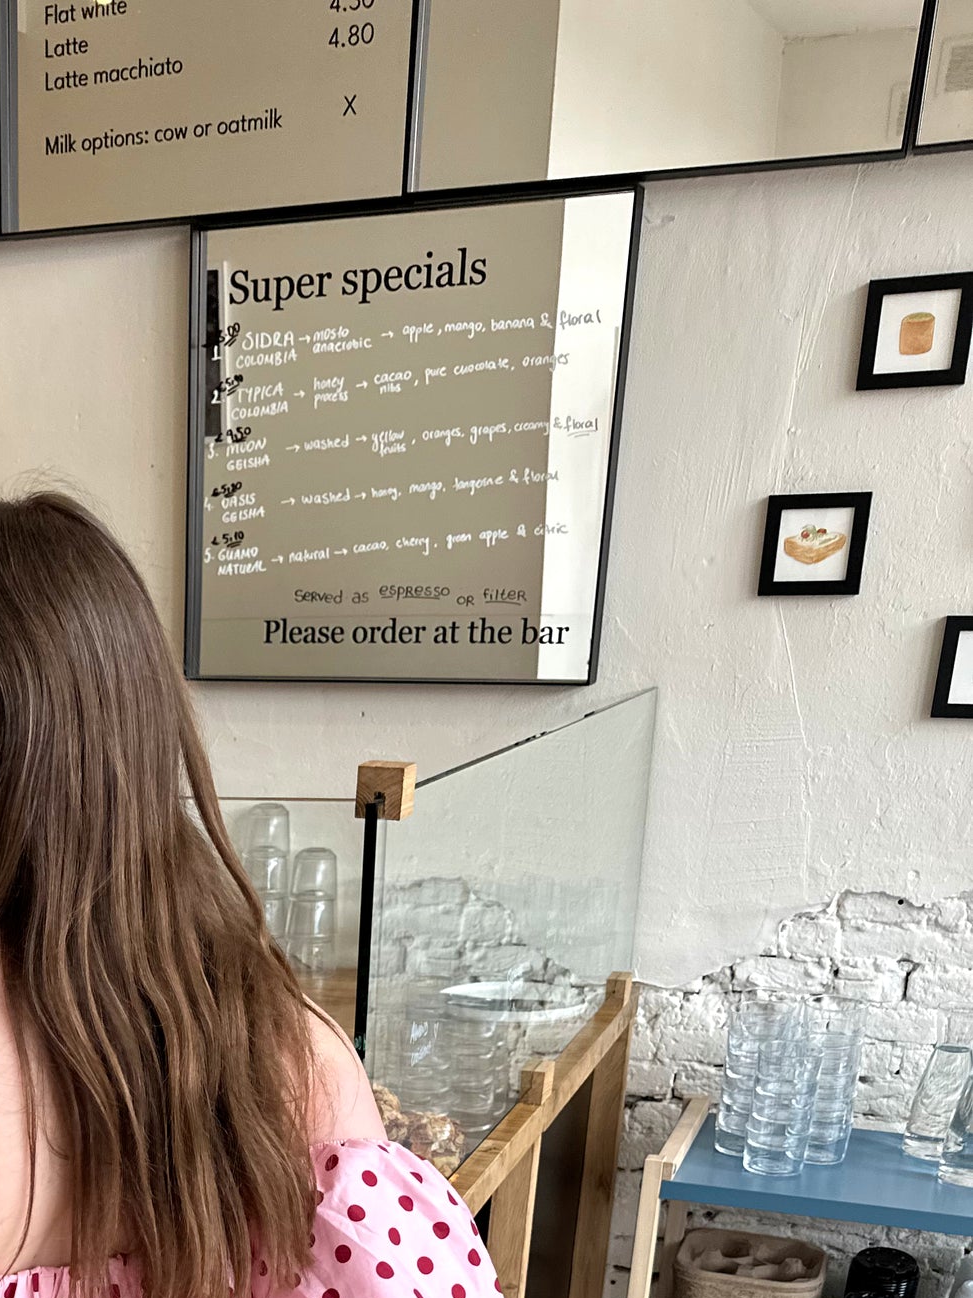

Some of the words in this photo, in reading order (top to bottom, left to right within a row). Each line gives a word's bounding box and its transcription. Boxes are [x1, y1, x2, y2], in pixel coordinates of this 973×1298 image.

[45, 4, 76, 26] Flat
[81, 0, 127, 20] white
[329, 22, 375, 48] 4.80
[45, 37, 89, 58] Latte
[45, 69, 89, 91] Latte
[94, 57, 183, 85] macchiato
[343, 94, 357, 116] X
[45, 133, 77, 156] Milk
[81, 128, 149, 155] options:
[155, 126, 187, 142] cow
[194, 123, 212, 138] or
[217, 108, 282, 135] oatmilk
[229, 269, 332, 311] Super
[341, 247, 487, 304] specials
[242, 331, 294, 350] SIDRA
[490, 317, 535, 332] banana
[559, 309, 602, 330] floral
[236, 348, 298, 369] COLOMBIA
[237, 381, 284, 403] TYPICA
[313, 376, 344, 393] honey
[425, 365, 447, 385] pure
[522, 352, 570, 373] oranges
[231, 401, 289, 421] COLOMBIA
[303, 434, 350, 451] washed
[226, 454, 270, 472] GEISHA
[301, 488, 351, 505] washed
[222, 506, 265, 523] GEISHA
[289, 547, 330, 564] natural
[479, 529, 509, 548] apple
[217, 560, 267, 576] NATURAL
[351, 592, 369, 604] as
[263, 617, 345, 645] Please
[352, 617, 427, 645] order
[433, 622, 460, 645] at
[468, 617, 512, 645] the
[521, 617, 570, 645] bar
